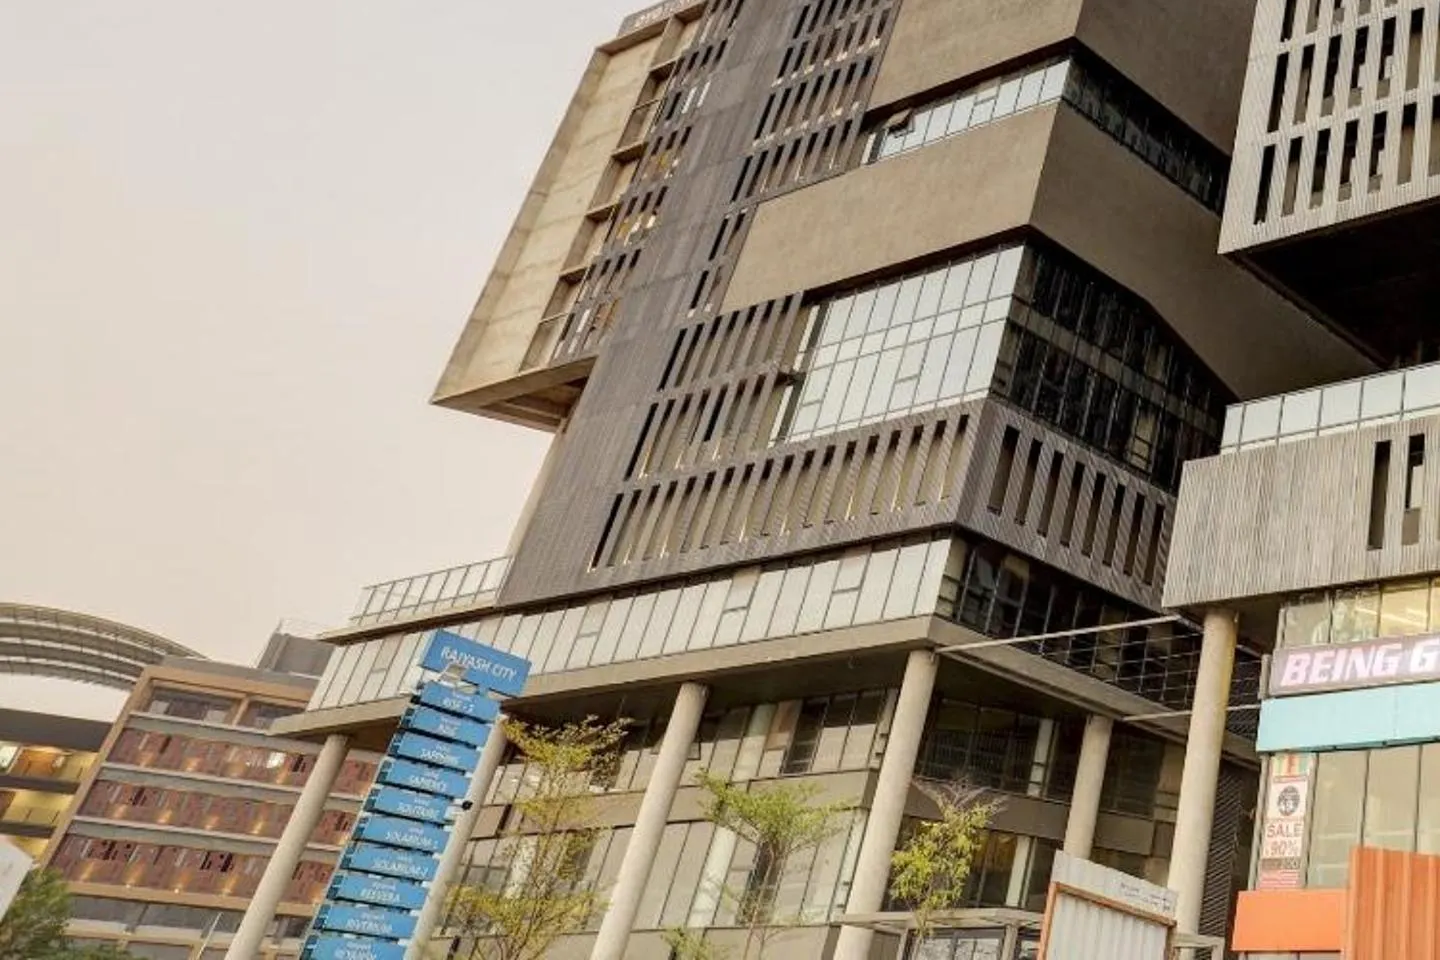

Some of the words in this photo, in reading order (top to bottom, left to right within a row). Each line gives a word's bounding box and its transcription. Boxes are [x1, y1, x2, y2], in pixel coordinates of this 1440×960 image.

[491, 663, 518, 681] CITY
[1280, 643, 1402, 687] BEING
[1267, 823, 1303, 838] SALE
